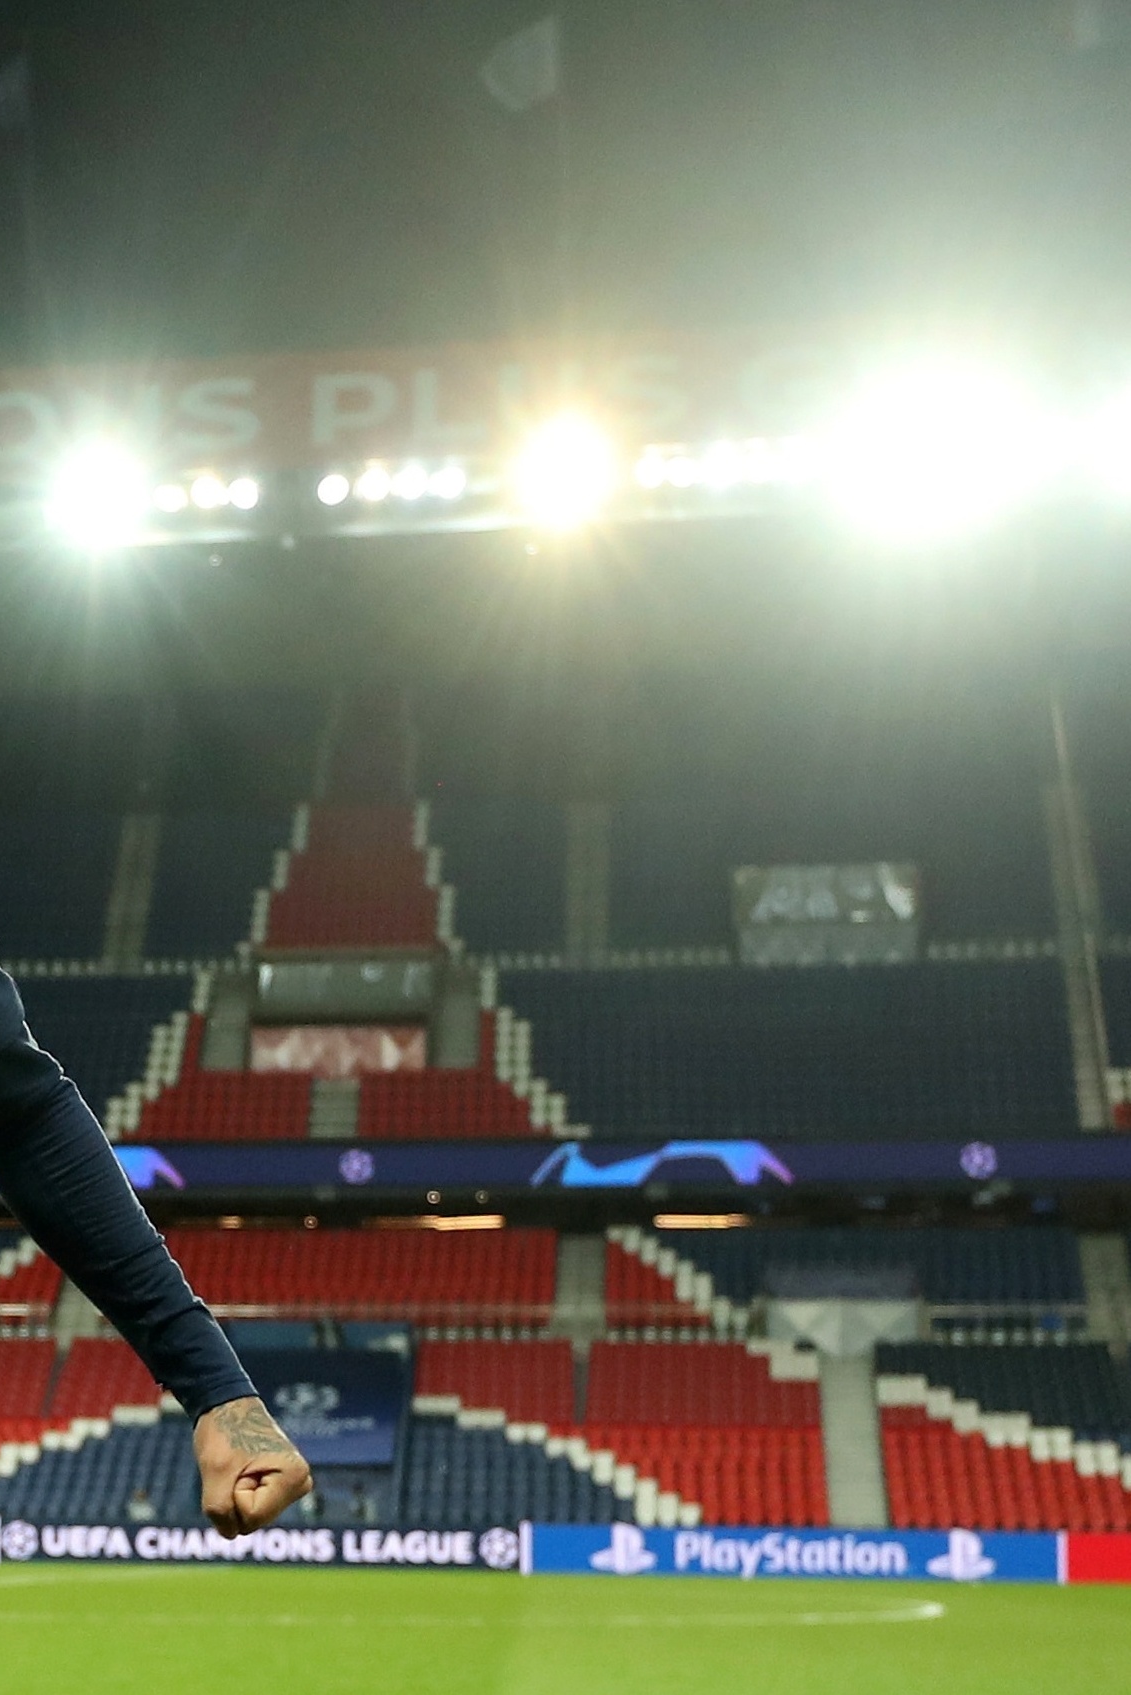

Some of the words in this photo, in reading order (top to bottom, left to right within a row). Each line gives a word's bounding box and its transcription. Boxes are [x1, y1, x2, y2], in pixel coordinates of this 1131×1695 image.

[40, 1524, 133, 1559] UEFA
[134, 1526, 336, 1562] CHAMPIONS
[342, 1529, 474, 1564] LEAGUE
[674, 1531, 908, 1581] PlayStation
